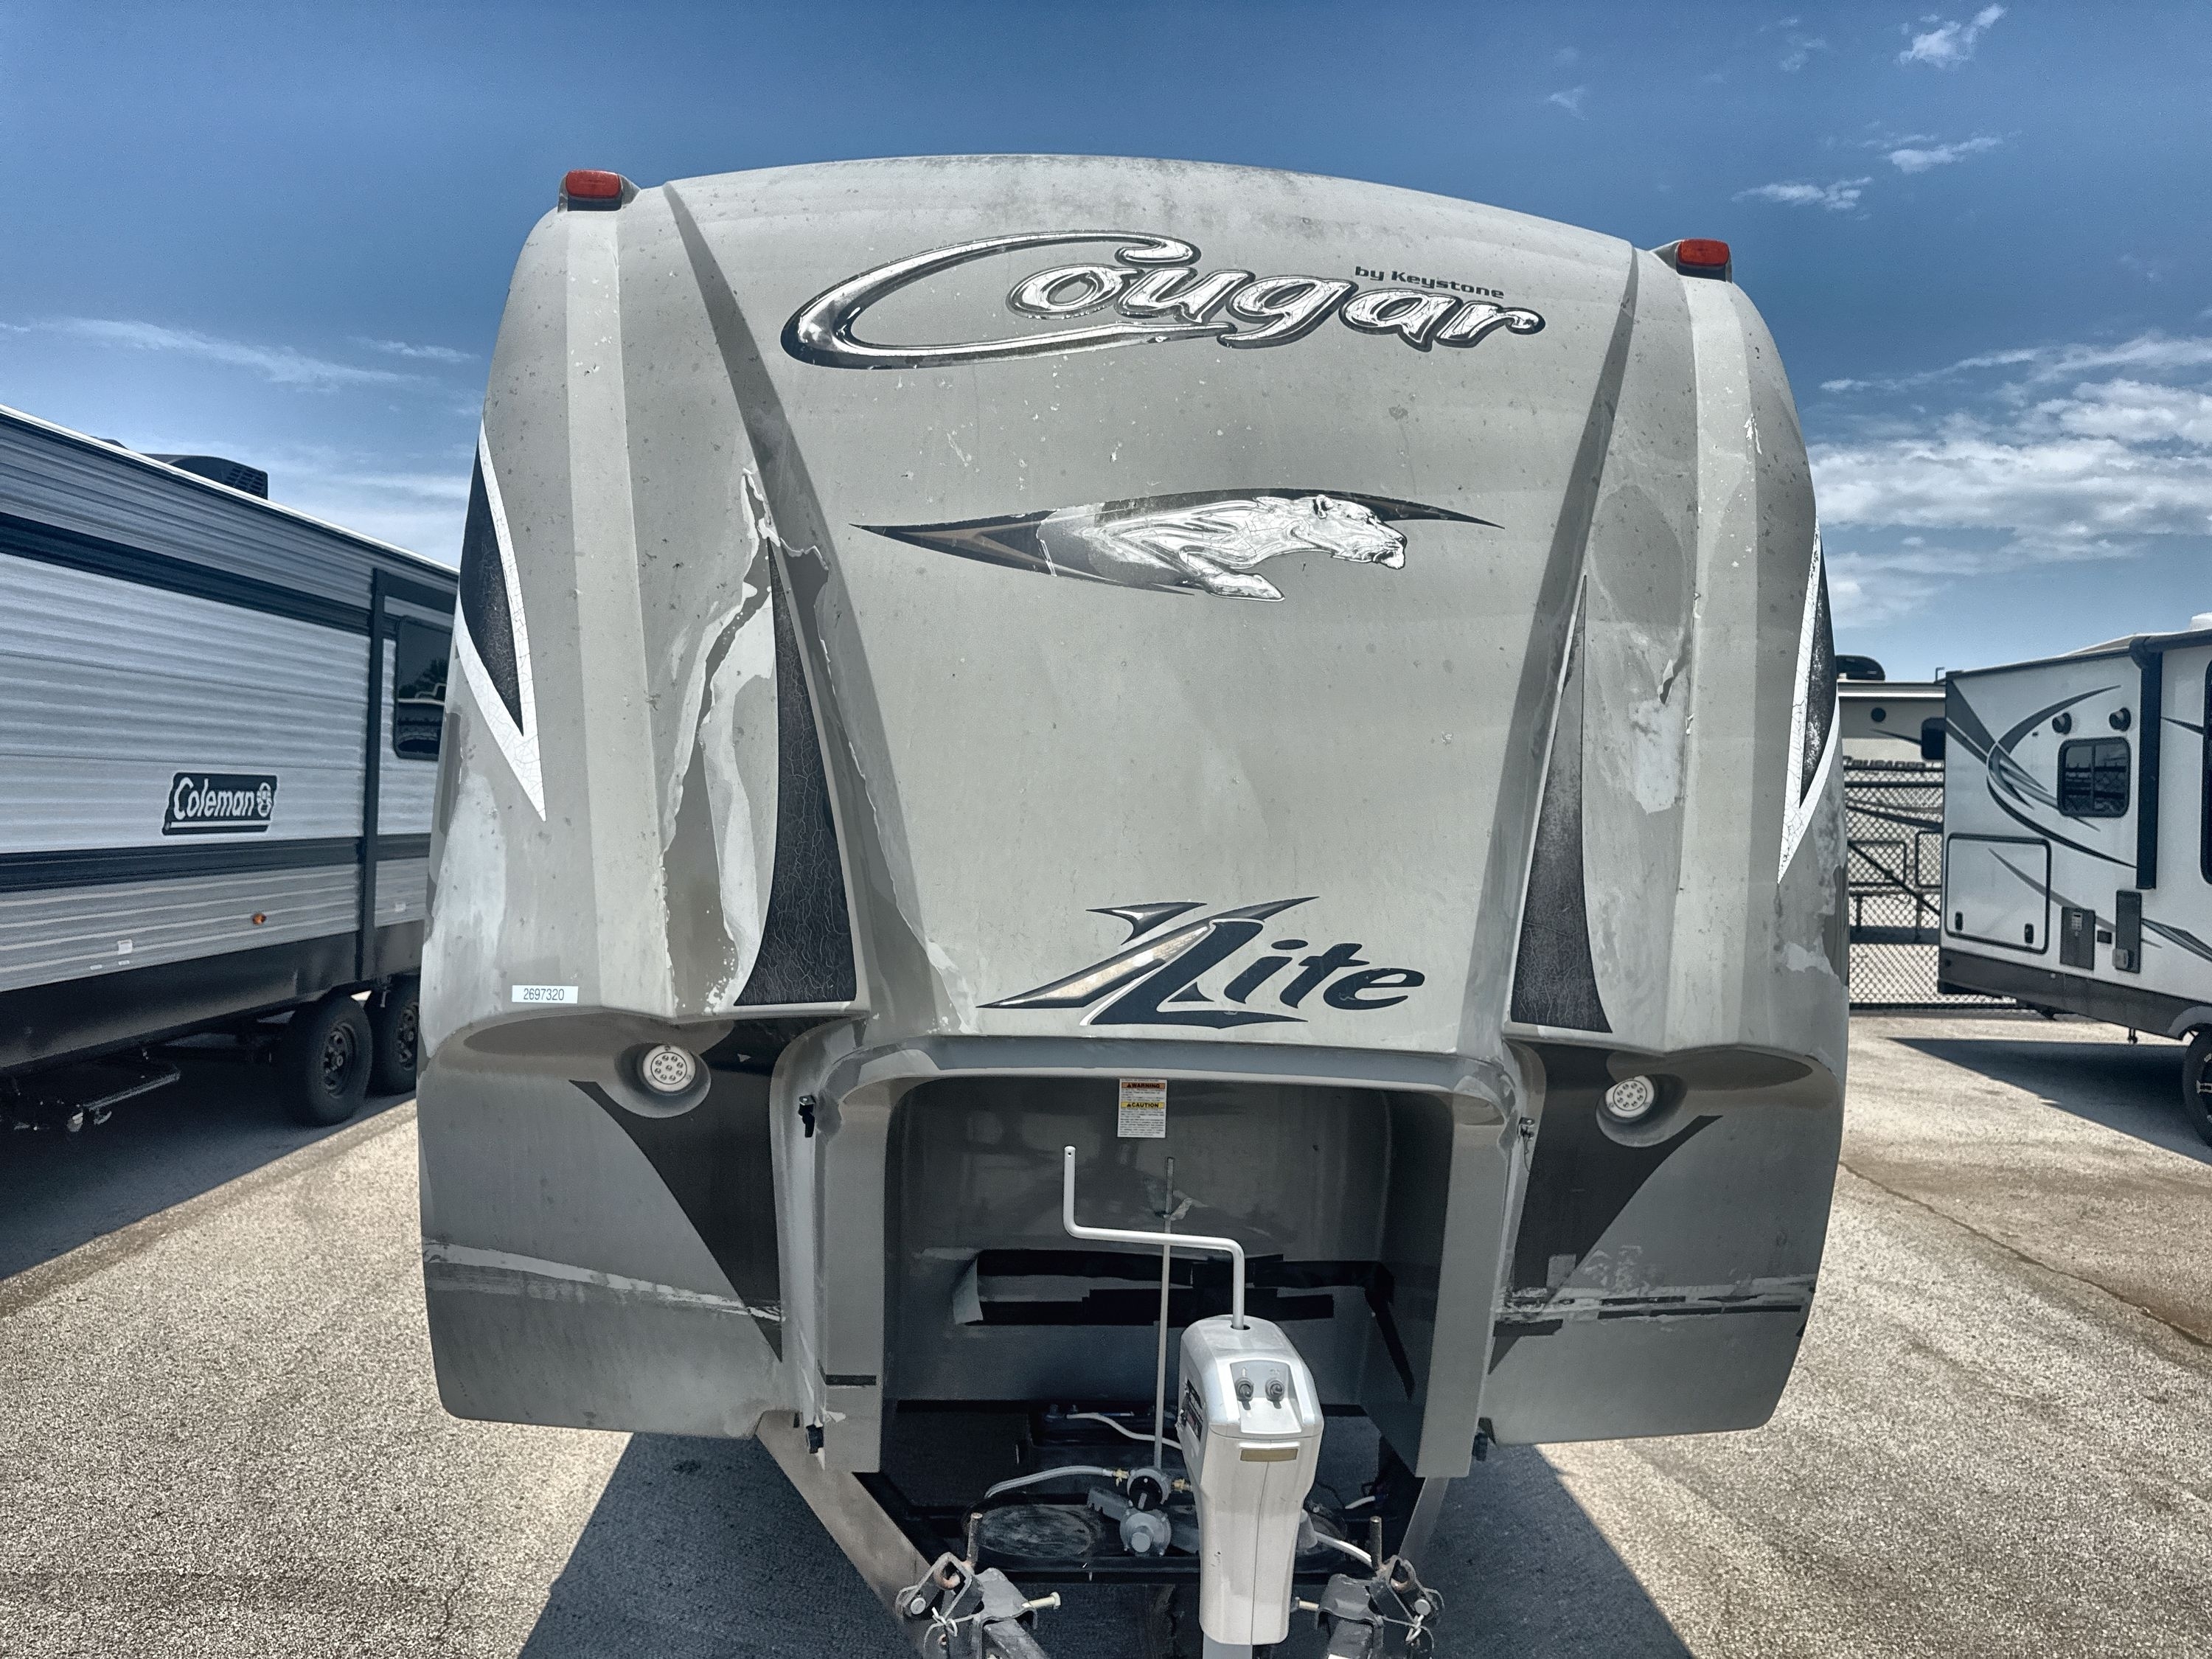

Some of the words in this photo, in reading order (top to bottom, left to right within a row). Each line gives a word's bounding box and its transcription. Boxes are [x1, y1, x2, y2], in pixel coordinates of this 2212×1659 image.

[780, 230, 1546, 371] Cougar
[1355, 266, 1384, 281] by
[1391, 271, 1504, 299] Keystone
[173, 776, 254, 820] Coleman
[524, 988, 565, 1001] 2697320
